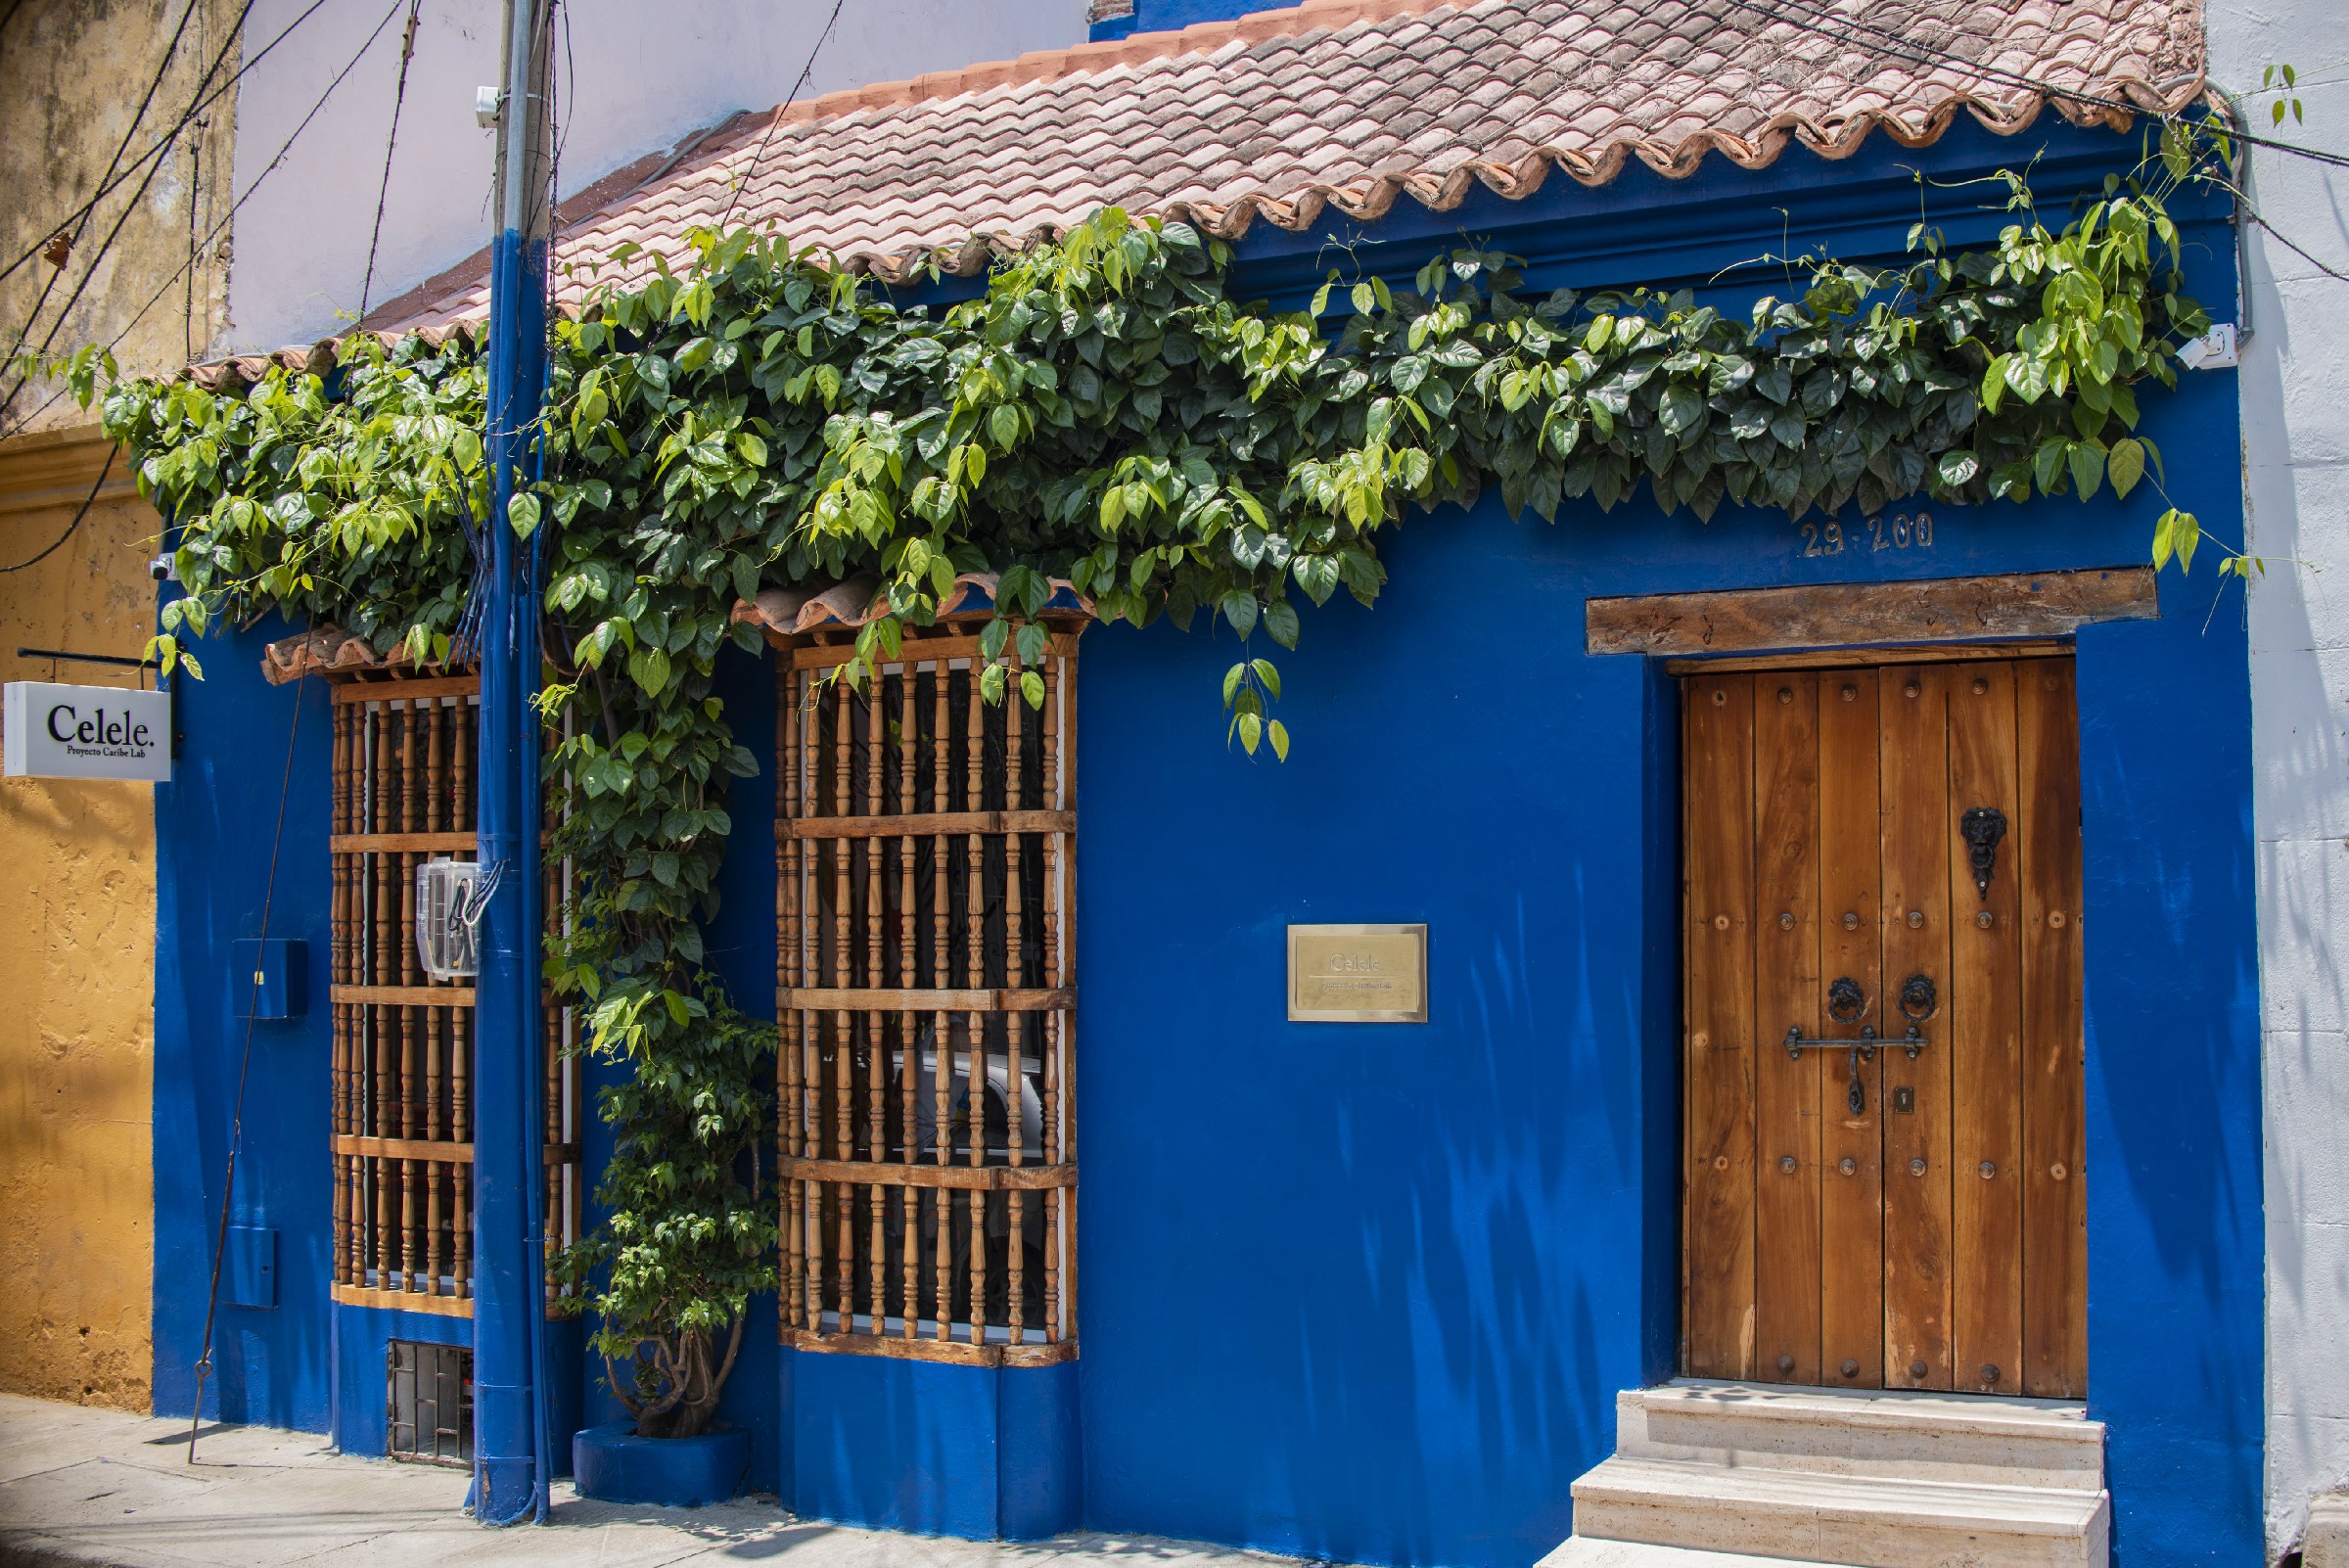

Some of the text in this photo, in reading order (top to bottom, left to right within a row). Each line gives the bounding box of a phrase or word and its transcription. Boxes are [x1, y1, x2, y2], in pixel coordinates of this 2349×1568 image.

[48, 705, 155, 747] Celele.
[67, 745, 146, 759] Proyecto Caribe Lab
